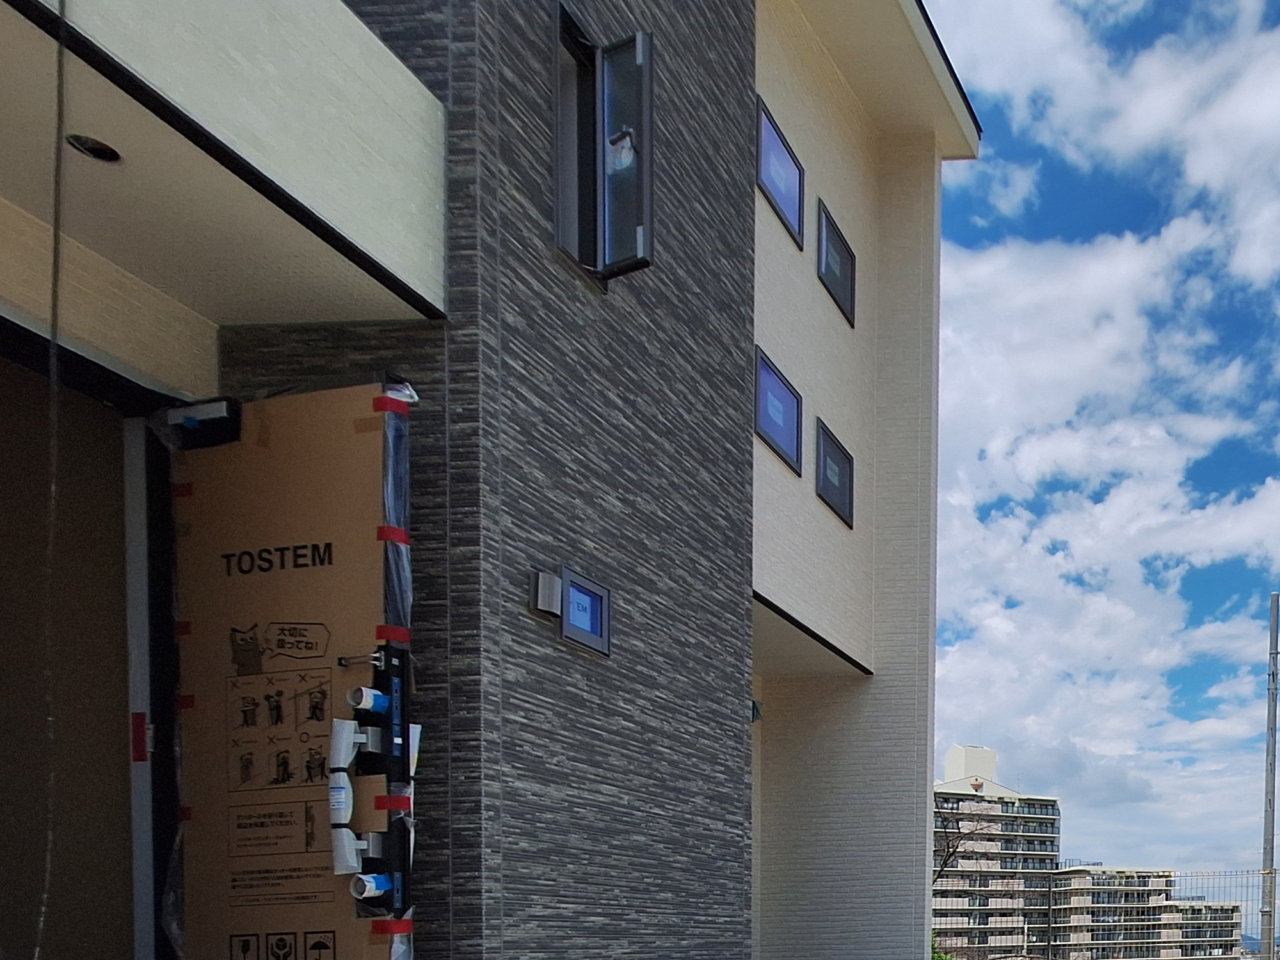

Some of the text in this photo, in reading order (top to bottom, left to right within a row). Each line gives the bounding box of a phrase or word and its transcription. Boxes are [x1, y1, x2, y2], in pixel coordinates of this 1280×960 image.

[221, 542, 333, 576] TOSTEM
[277, 627, 308, 638] 大切に
